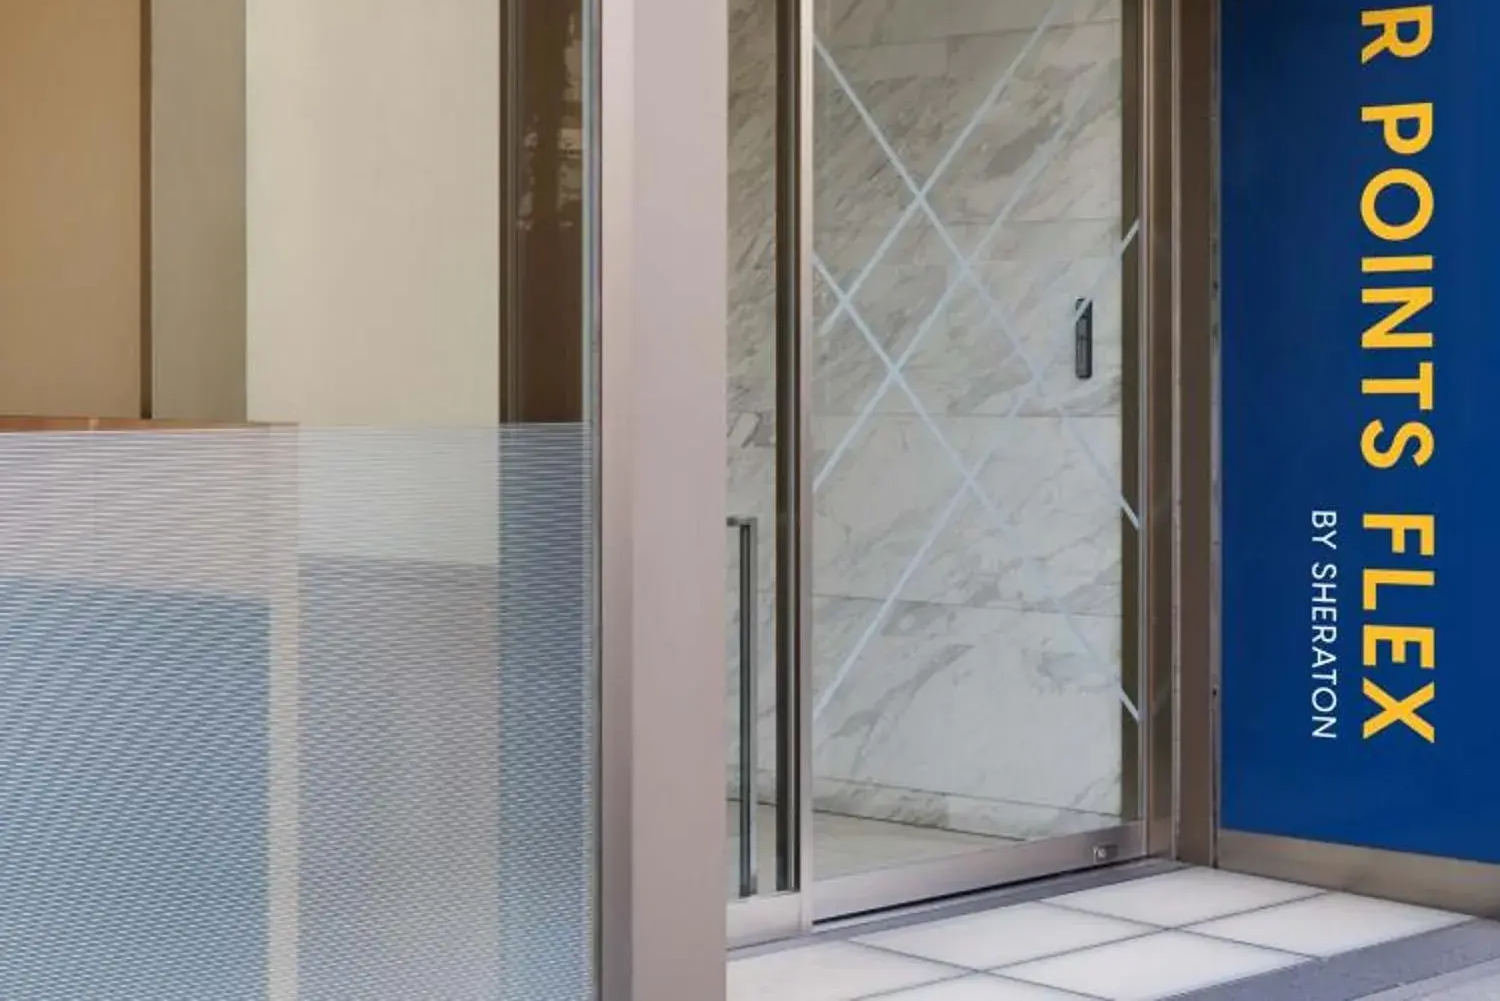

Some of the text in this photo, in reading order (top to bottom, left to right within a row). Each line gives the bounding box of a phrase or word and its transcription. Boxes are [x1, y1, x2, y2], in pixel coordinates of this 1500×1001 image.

[1360, 102, 1434, 469] POINTS
[1311, 510, 1337, 739] BY SHERATON
[1362, 513, 1435, 743] FLEX
